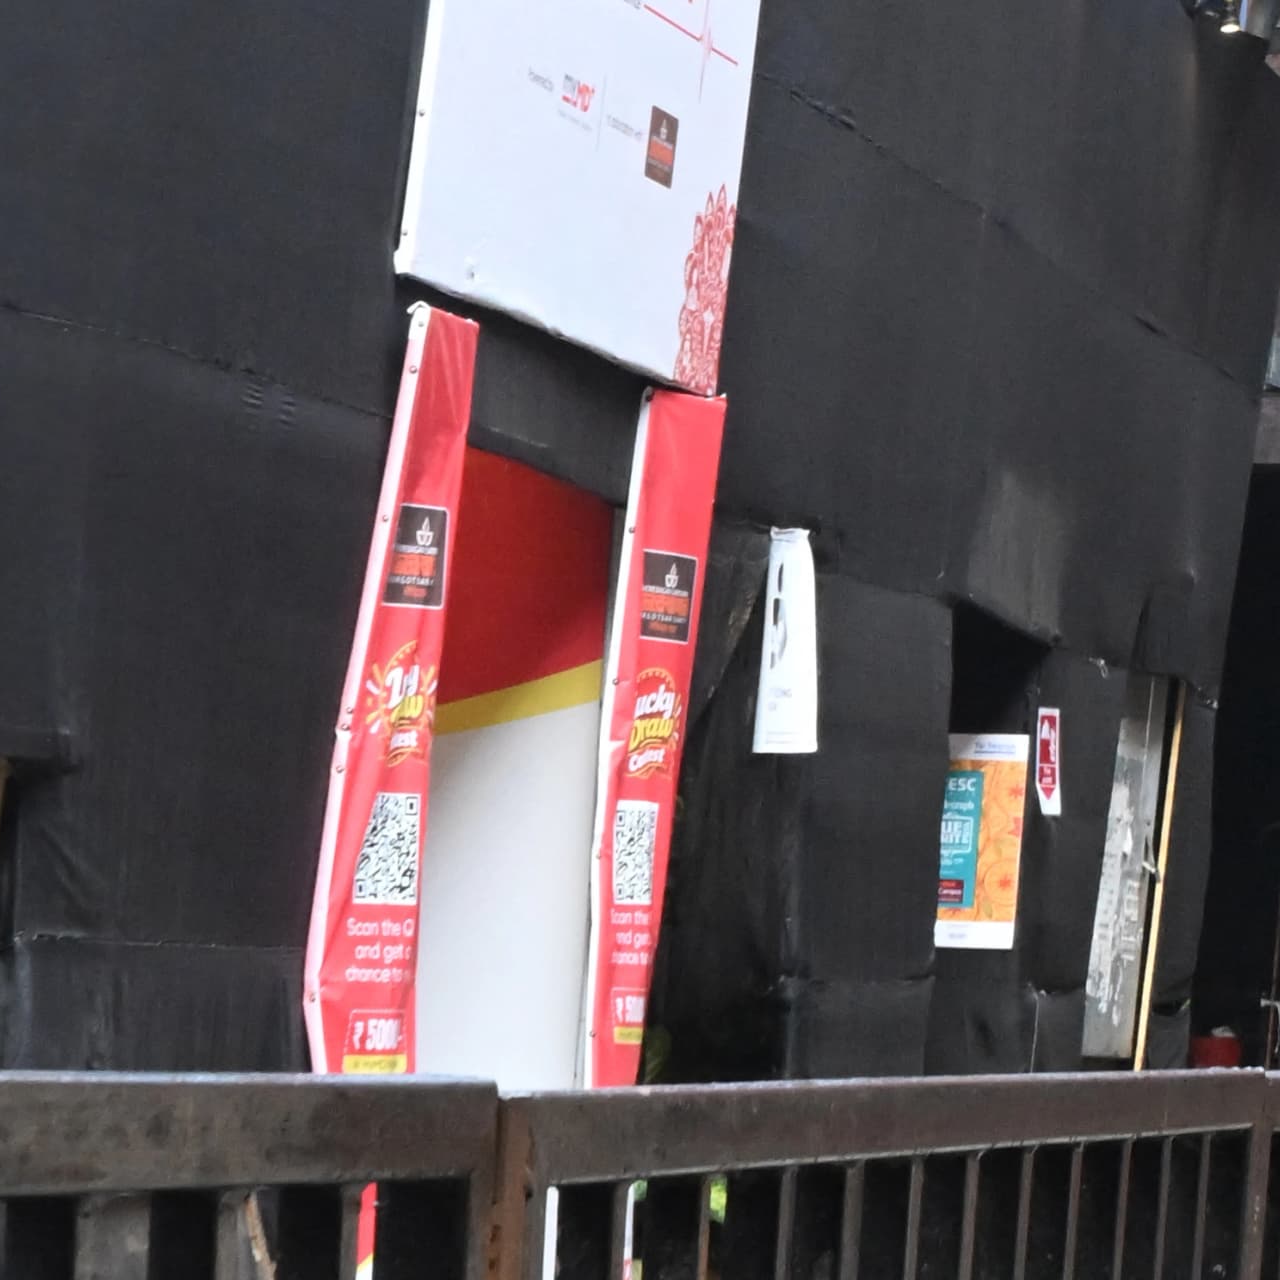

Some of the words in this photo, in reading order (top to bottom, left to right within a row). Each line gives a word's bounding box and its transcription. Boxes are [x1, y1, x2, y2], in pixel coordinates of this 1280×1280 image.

[635, 685, 675, 719] ucky
[947, 777, 977, 792] ESC
[347, 917, 379, 936] Scan
[381, 919, 401, 936] the
[402, 918, 415, 936] Q
[355, 941, 380, 960] and
[383, 944, 403, 964] get
[345, 965, 390, 983] chance
